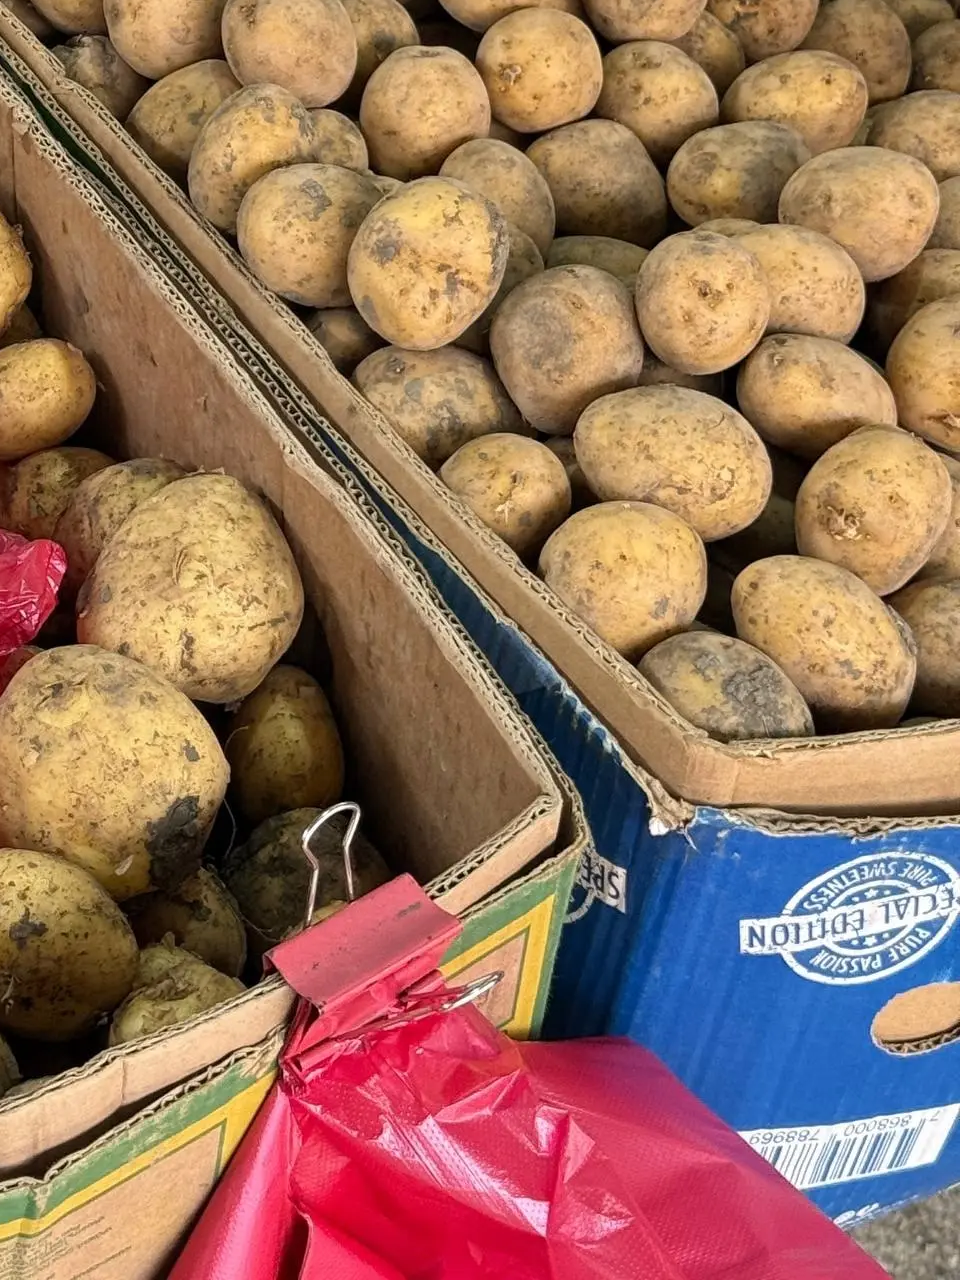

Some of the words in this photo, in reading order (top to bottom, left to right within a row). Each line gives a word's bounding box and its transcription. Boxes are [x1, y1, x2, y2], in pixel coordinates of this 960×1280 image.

[803, 861, 899, 911] SWEETNESS
[900, 861, 939, 887] PURE
[879, 890, 959, 924] ECIAL
[748, 908, 865, 948] EDITION
[809, 948, 883, 973] PASSION
[749, 1129, 820, 1145] 788969
[843, 1115, 912, 1137] 868000
